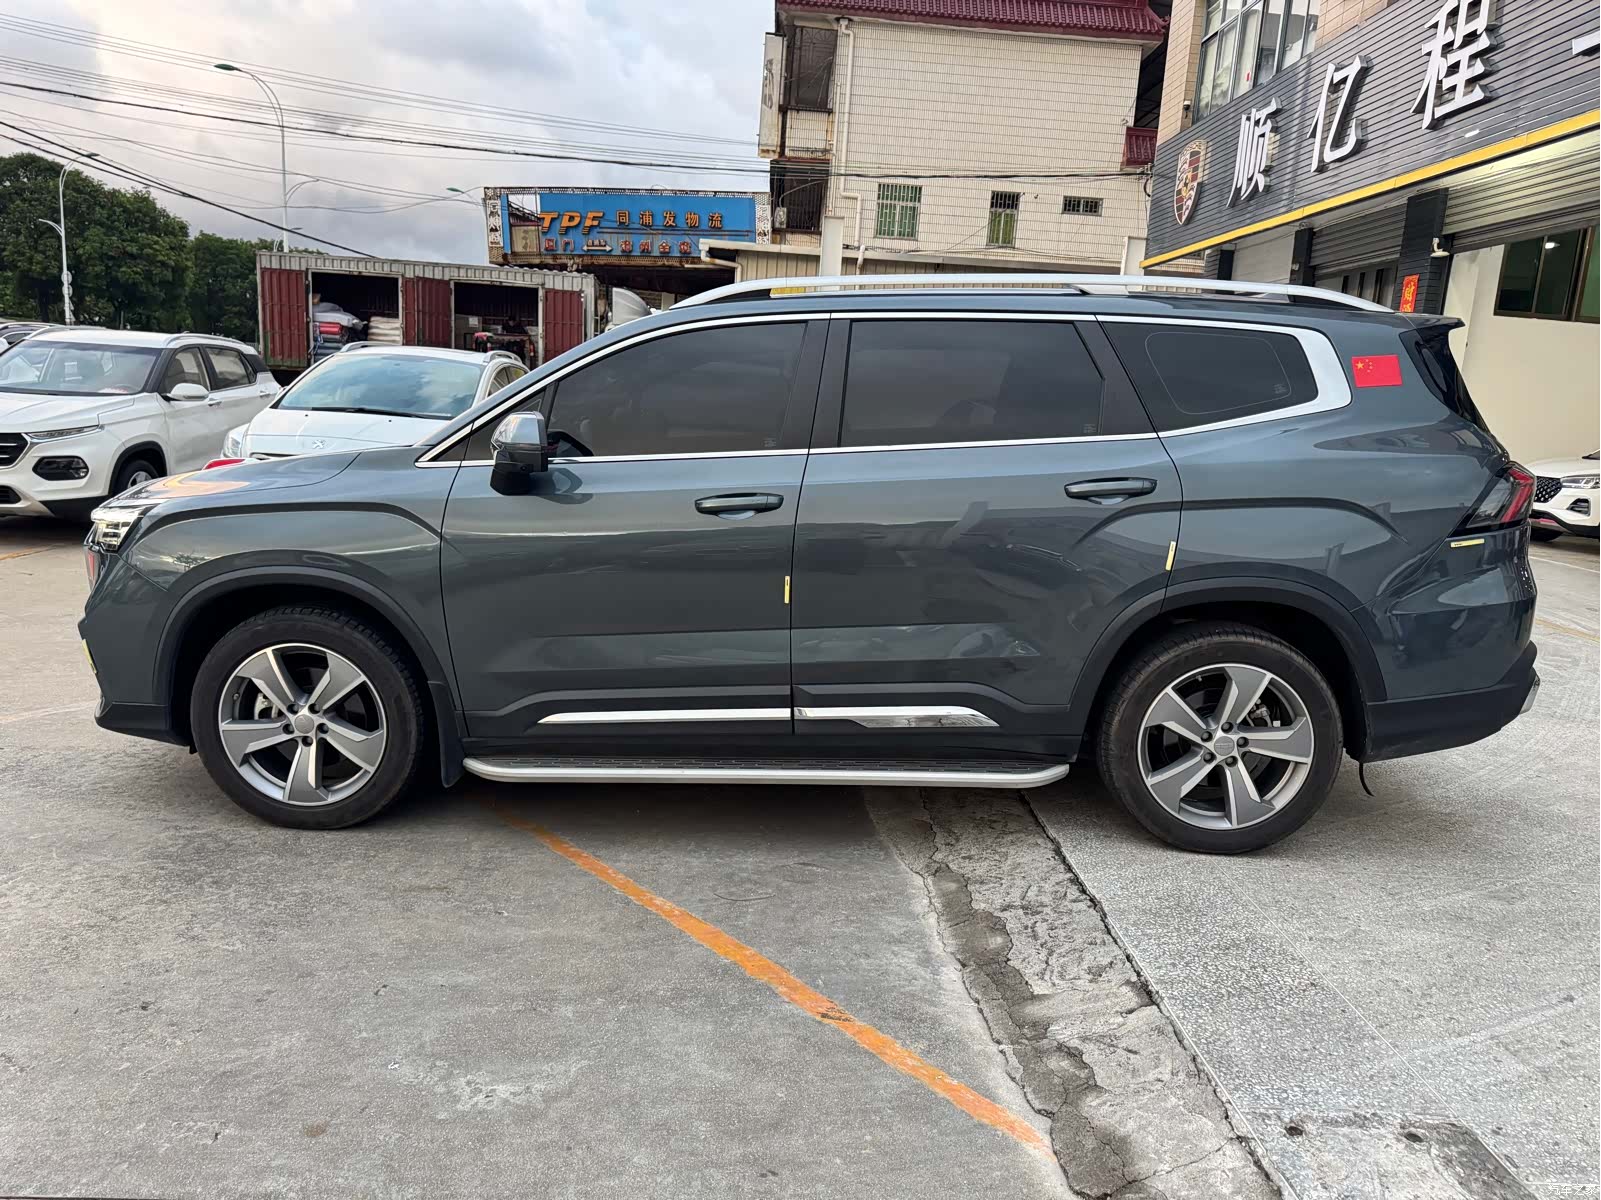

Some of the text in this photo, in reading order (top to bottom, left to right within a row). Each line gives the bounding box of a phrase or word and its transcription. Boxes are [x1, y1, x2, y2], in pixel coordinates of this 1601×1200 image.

[1226, 0, 1600, 208] 顺亿程
[540, 210, 723, 234] TPF 同浦发物流
